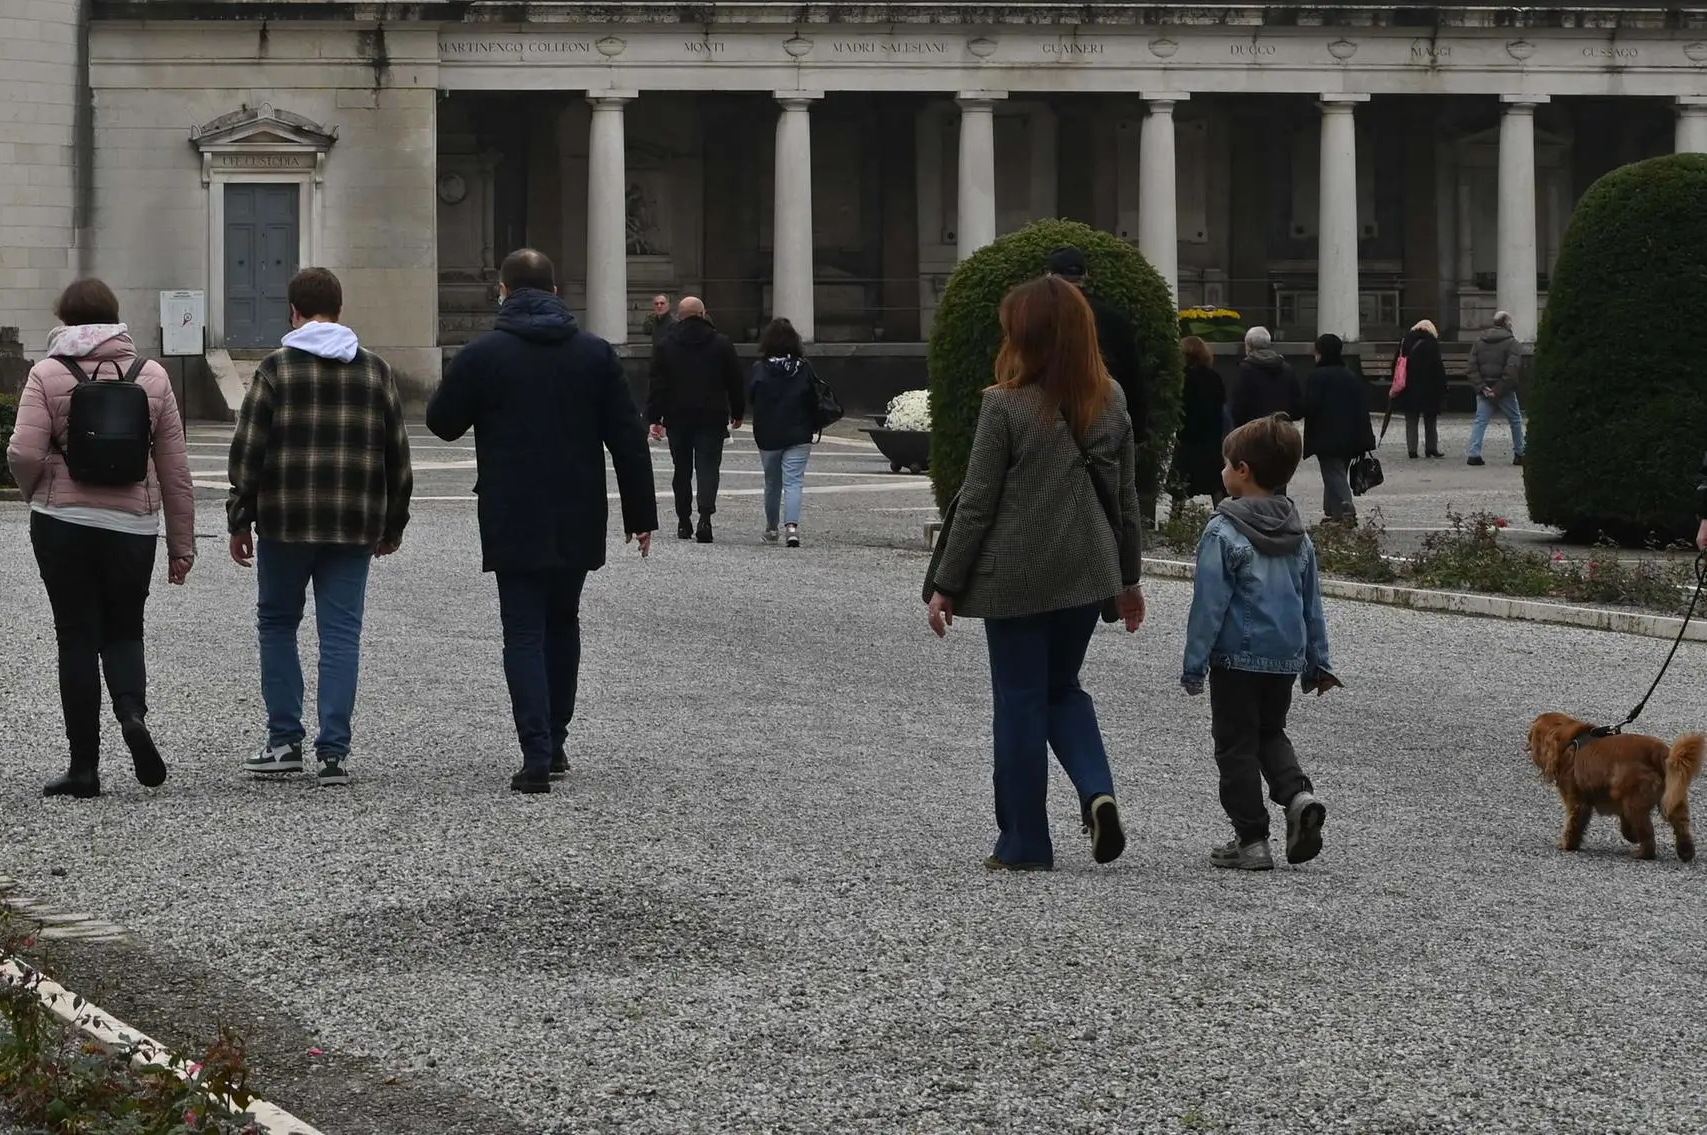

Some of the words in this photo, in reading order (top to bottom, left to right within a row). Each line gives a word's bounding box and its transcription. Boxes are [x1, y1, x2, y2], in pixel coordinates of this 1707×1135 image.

[437, 42, 523, 54] MARTINENGO
[529, 42, 590, 54] COLLEONI
[684, 42, 726, 54] MONTI
[833, 42, 877, 54] MADRI
[881, 42, 948, 55] SALESIANE
[1410, 46, 1452, 58] MAGGI
[1582, 47, 1638, 57] CUSSAGO
